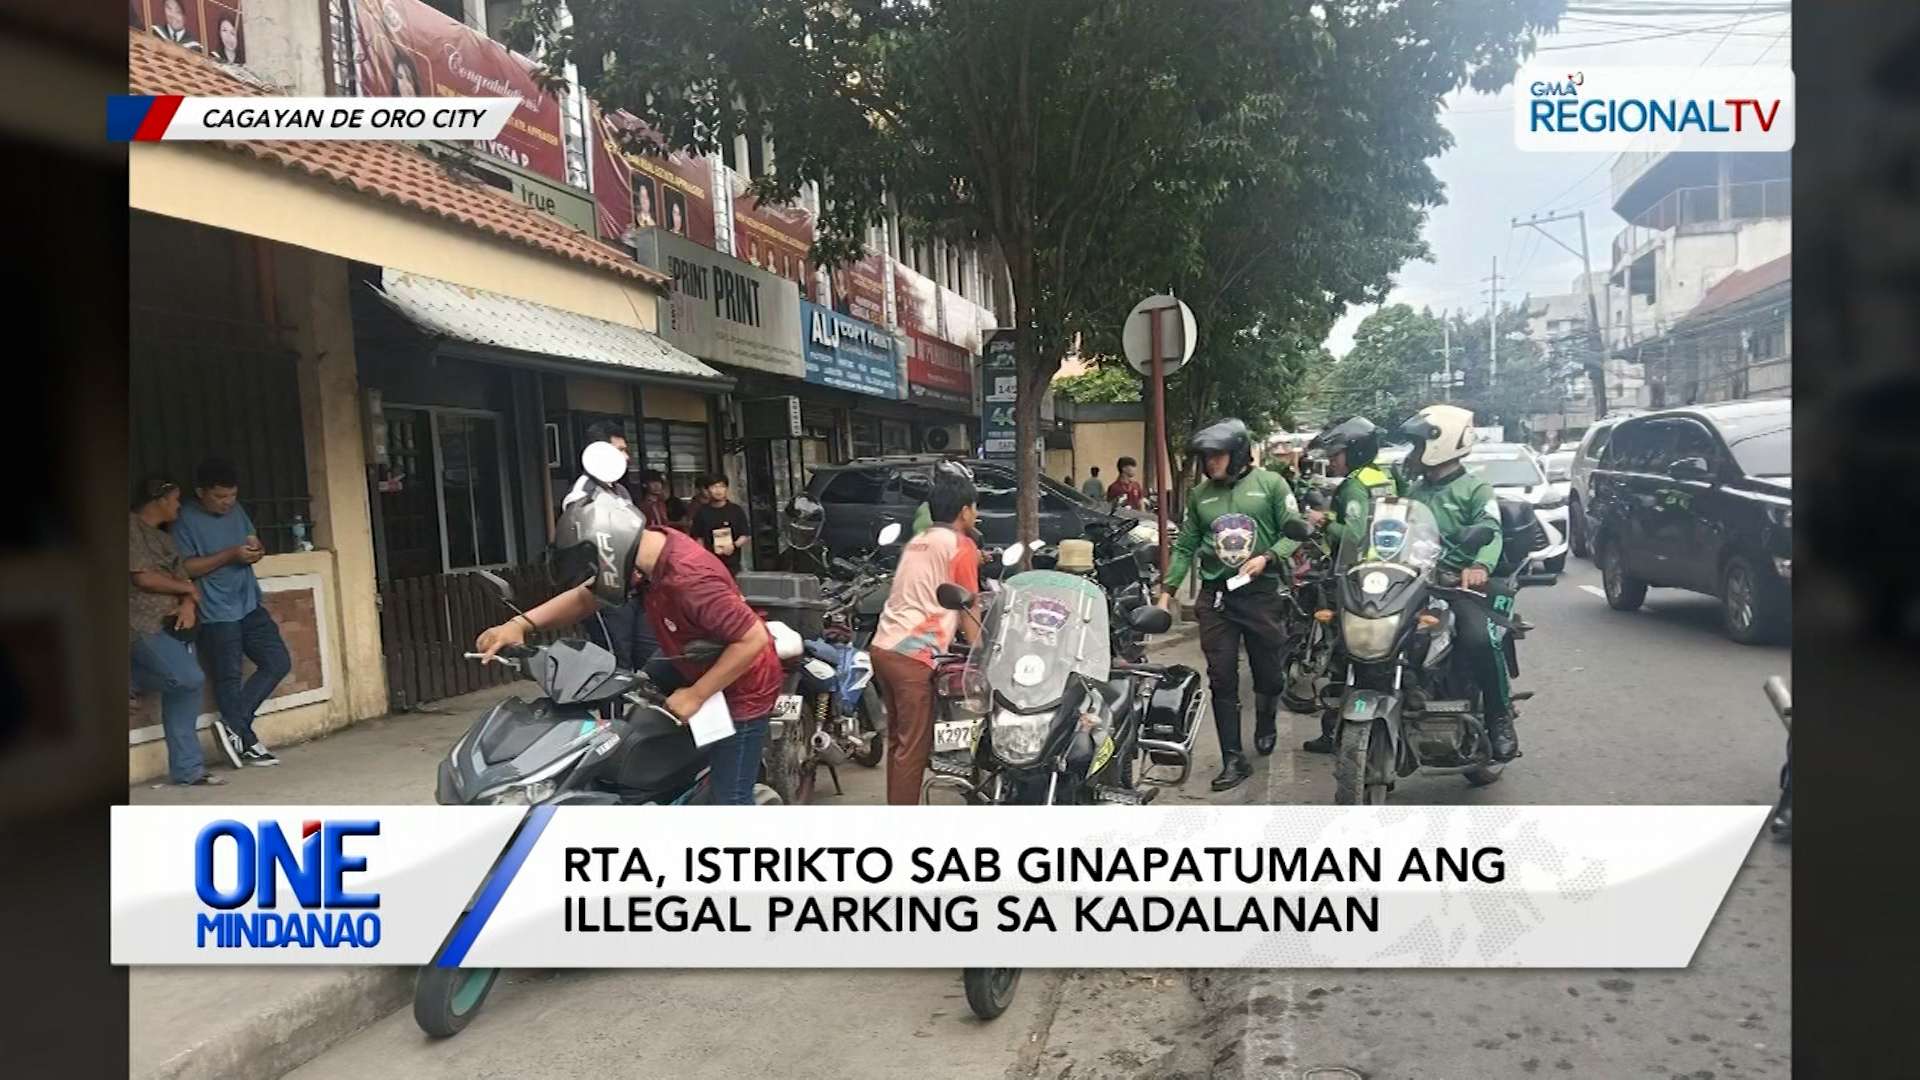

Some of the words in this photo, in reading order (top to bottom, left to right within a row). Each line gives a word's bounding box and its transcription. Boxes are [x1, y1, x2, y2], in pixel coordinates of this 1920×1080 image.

[521, 183, 556, 216] true
[672, 257, 708, 300] PRINT
[712, 265, 760, 328] PRINT
[810, 311, 840, 348] ALJ
